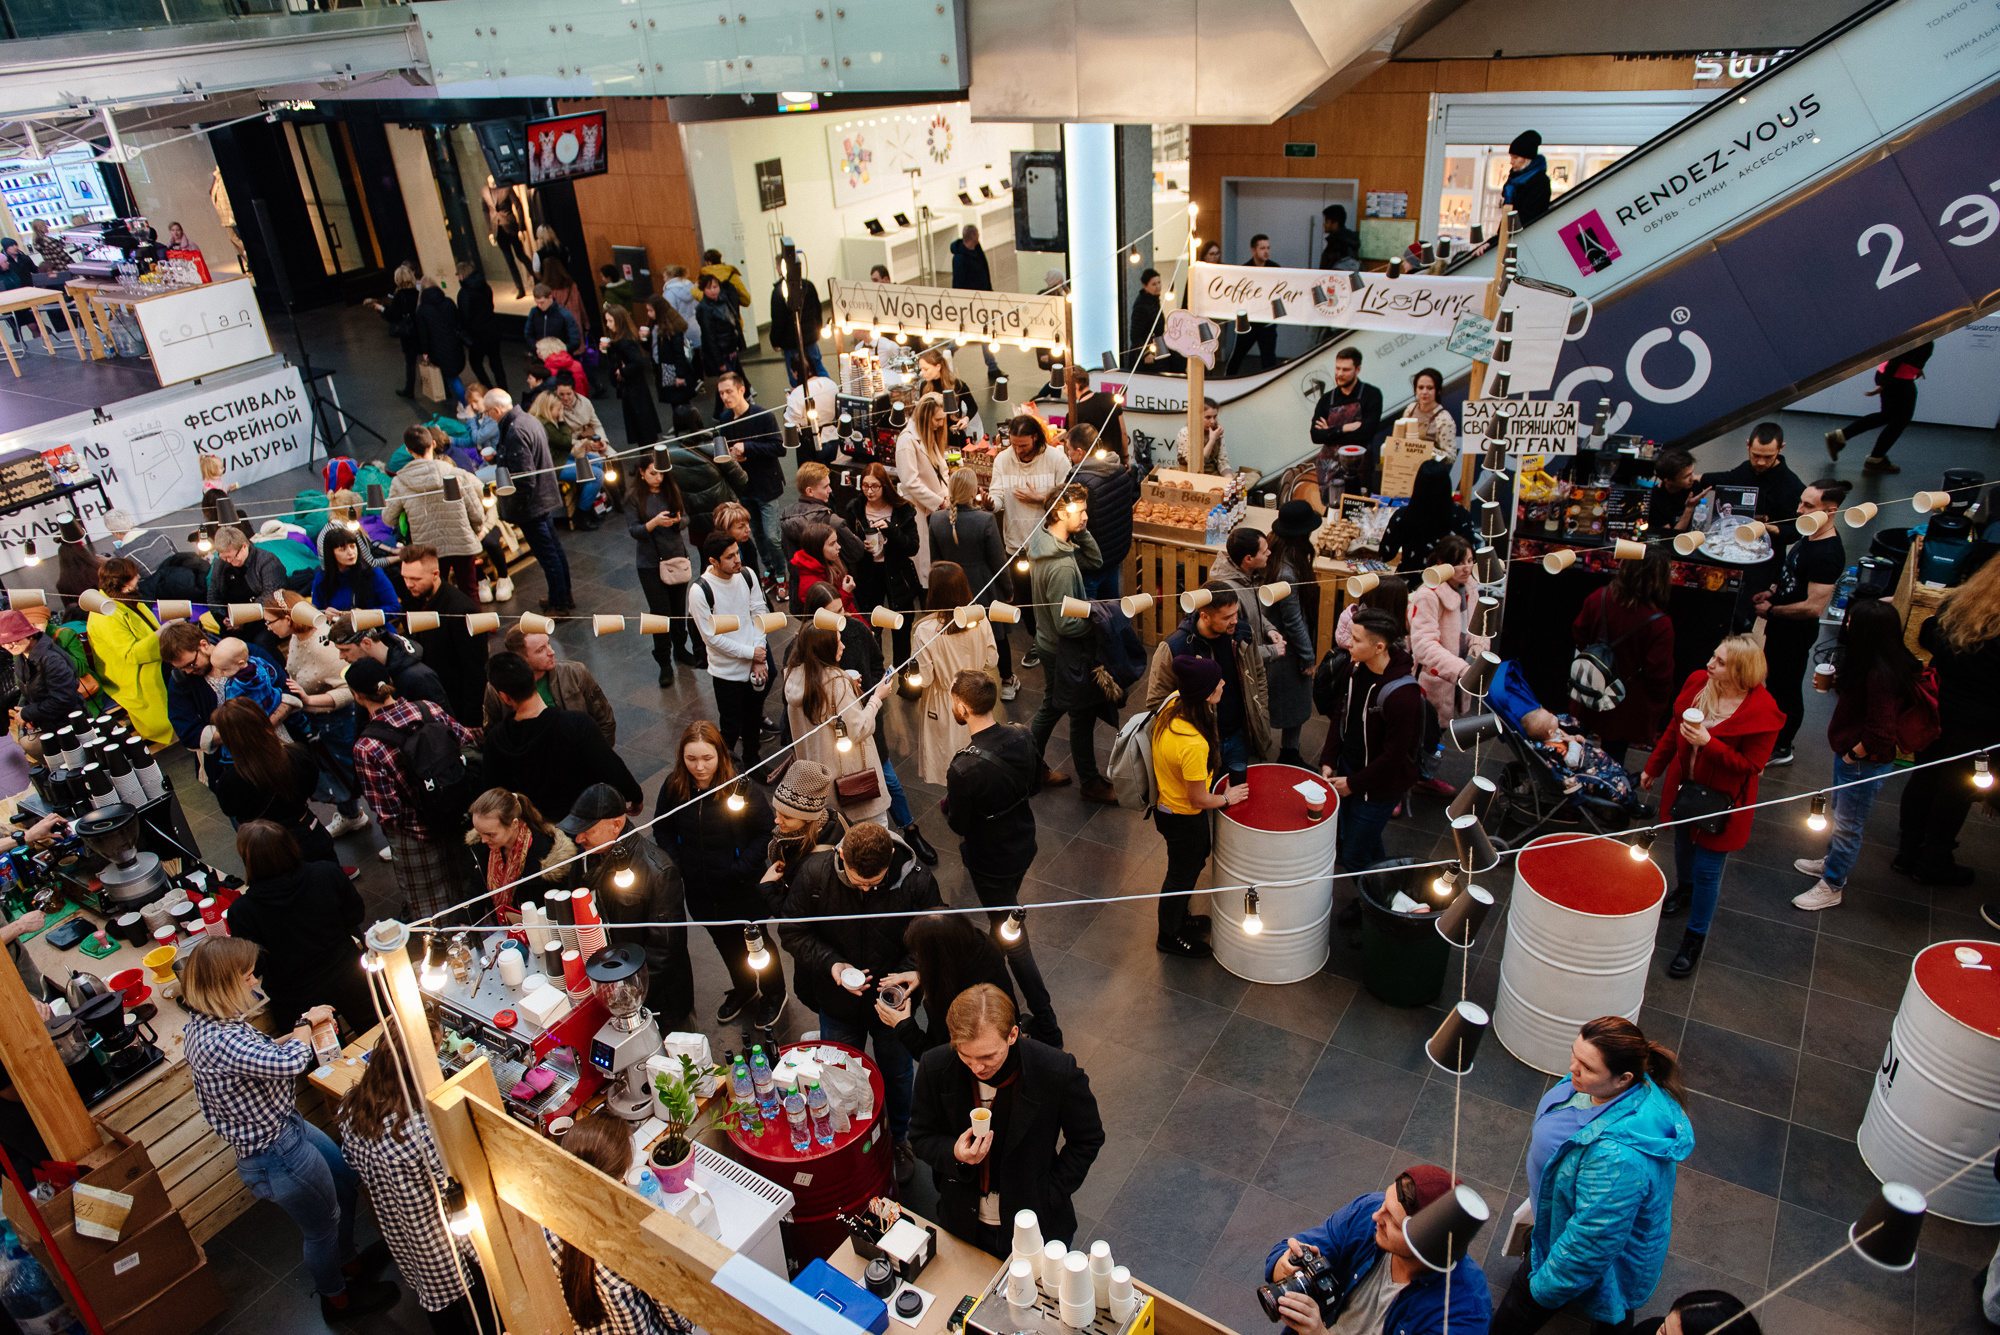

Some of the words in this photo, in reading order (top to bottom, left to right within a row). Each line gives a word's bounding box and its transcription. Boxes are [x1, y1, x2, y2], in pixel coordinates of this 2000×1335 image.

[1926, 2, 1967, 29] ТОЛЬКО
[1615, 93, 1821, 226] RENDEZ-VOUS
[71, 180, 88, 193] 10
[1643, 208, 1679, 233] ОБУВЬ
[1688, 180, 1728, 208] СУМКИ
[1738, 128, 1816, 179] АКСЕССУАРЫ
[1857, 223, 1921, 290] 2
[1208, 276, 1262, 304] Coffee
[1268, 280, 1303, 303] Bar
[1356, 283, 1390, 316] Lis
[1408, 288, 1475, 320] Boris
[879, 293, 1020, 332] Wonderland
[1029, 316, 1046, 326] TEA
[1400, 350, 1425, 368] MARC
[184, 385, 297, 430] ФЕСТИВАЛЬ
[1463, 402, 1548, 418] ЗАХОДИ
[1553, 403, 1574, 418] ЗА
[193, 405, 302, 454] КОФЕЙНОЙ
[1511, 420, 1576, 435] ПРЯНИКОМ
[221, 434, 299, 475] УЛЬТУРЫ
[18, 463, 26, 477] 2
[28, 483, 37, 496] 3
[1151, 487, 1165, 498] Lis
[1181, 491, 1211, 504] Boris
